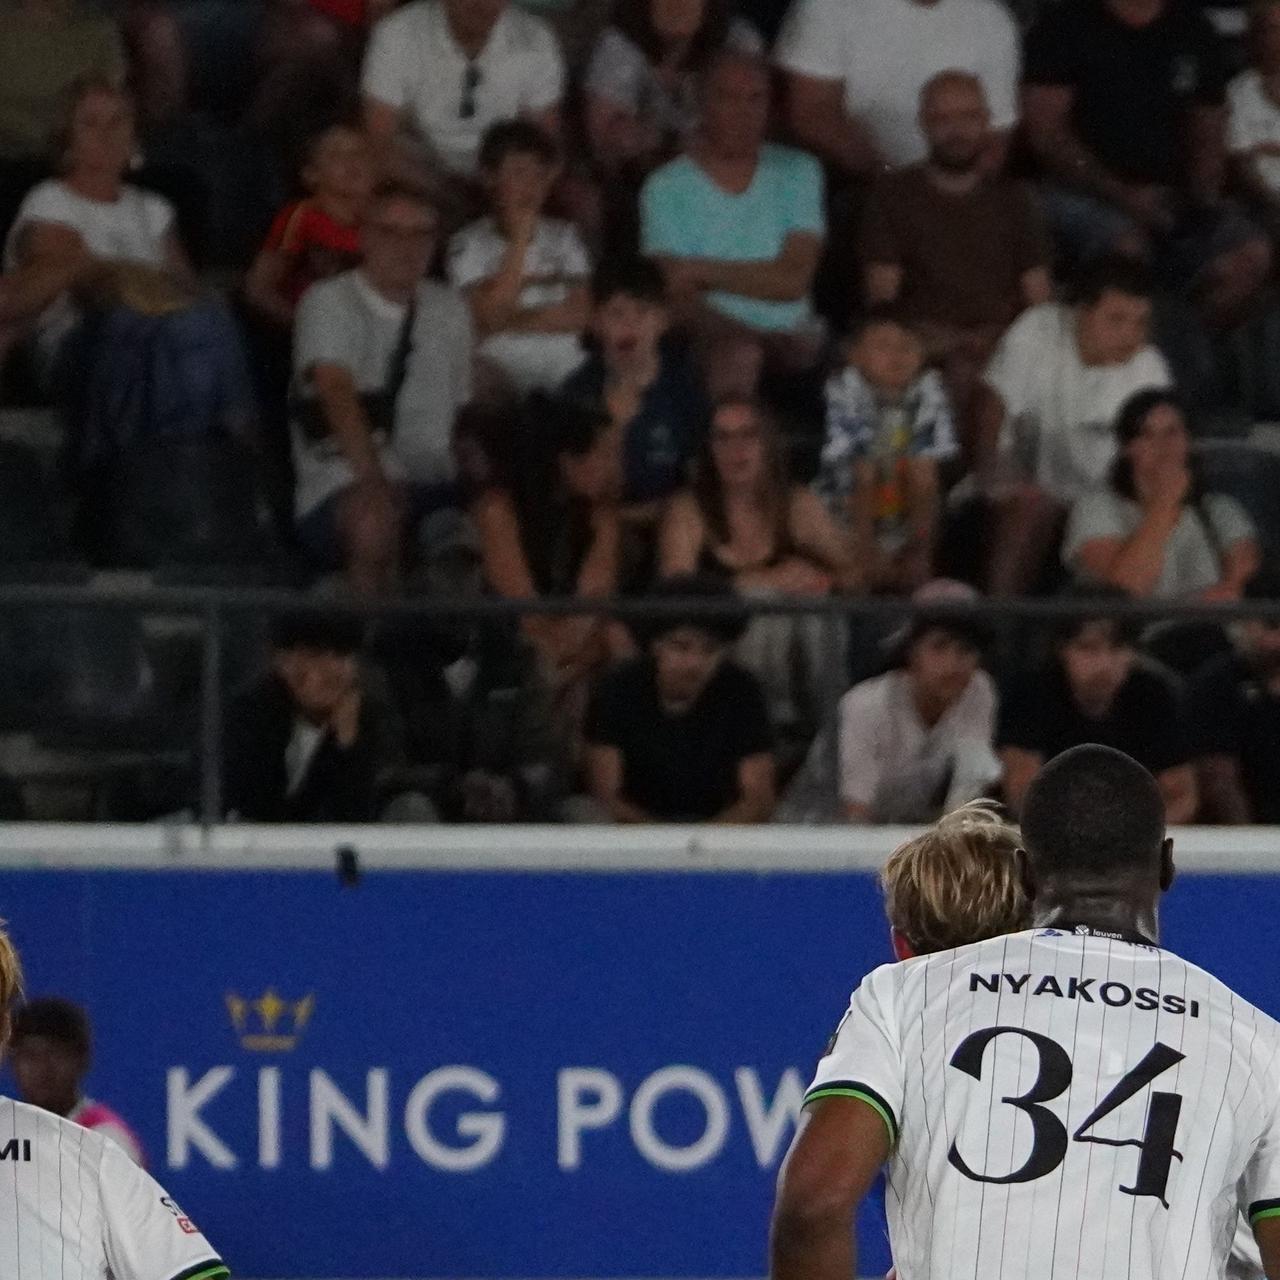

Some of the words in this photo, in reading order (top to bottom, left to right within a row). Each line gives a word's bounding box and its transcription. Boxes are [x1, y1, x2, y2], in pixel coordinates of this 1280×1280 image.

[969, 973, 1199, 1018] NYAKOSSI
[166, 1065, 505, 1171] KING
[947, 1026, 1187, 1210] 34
